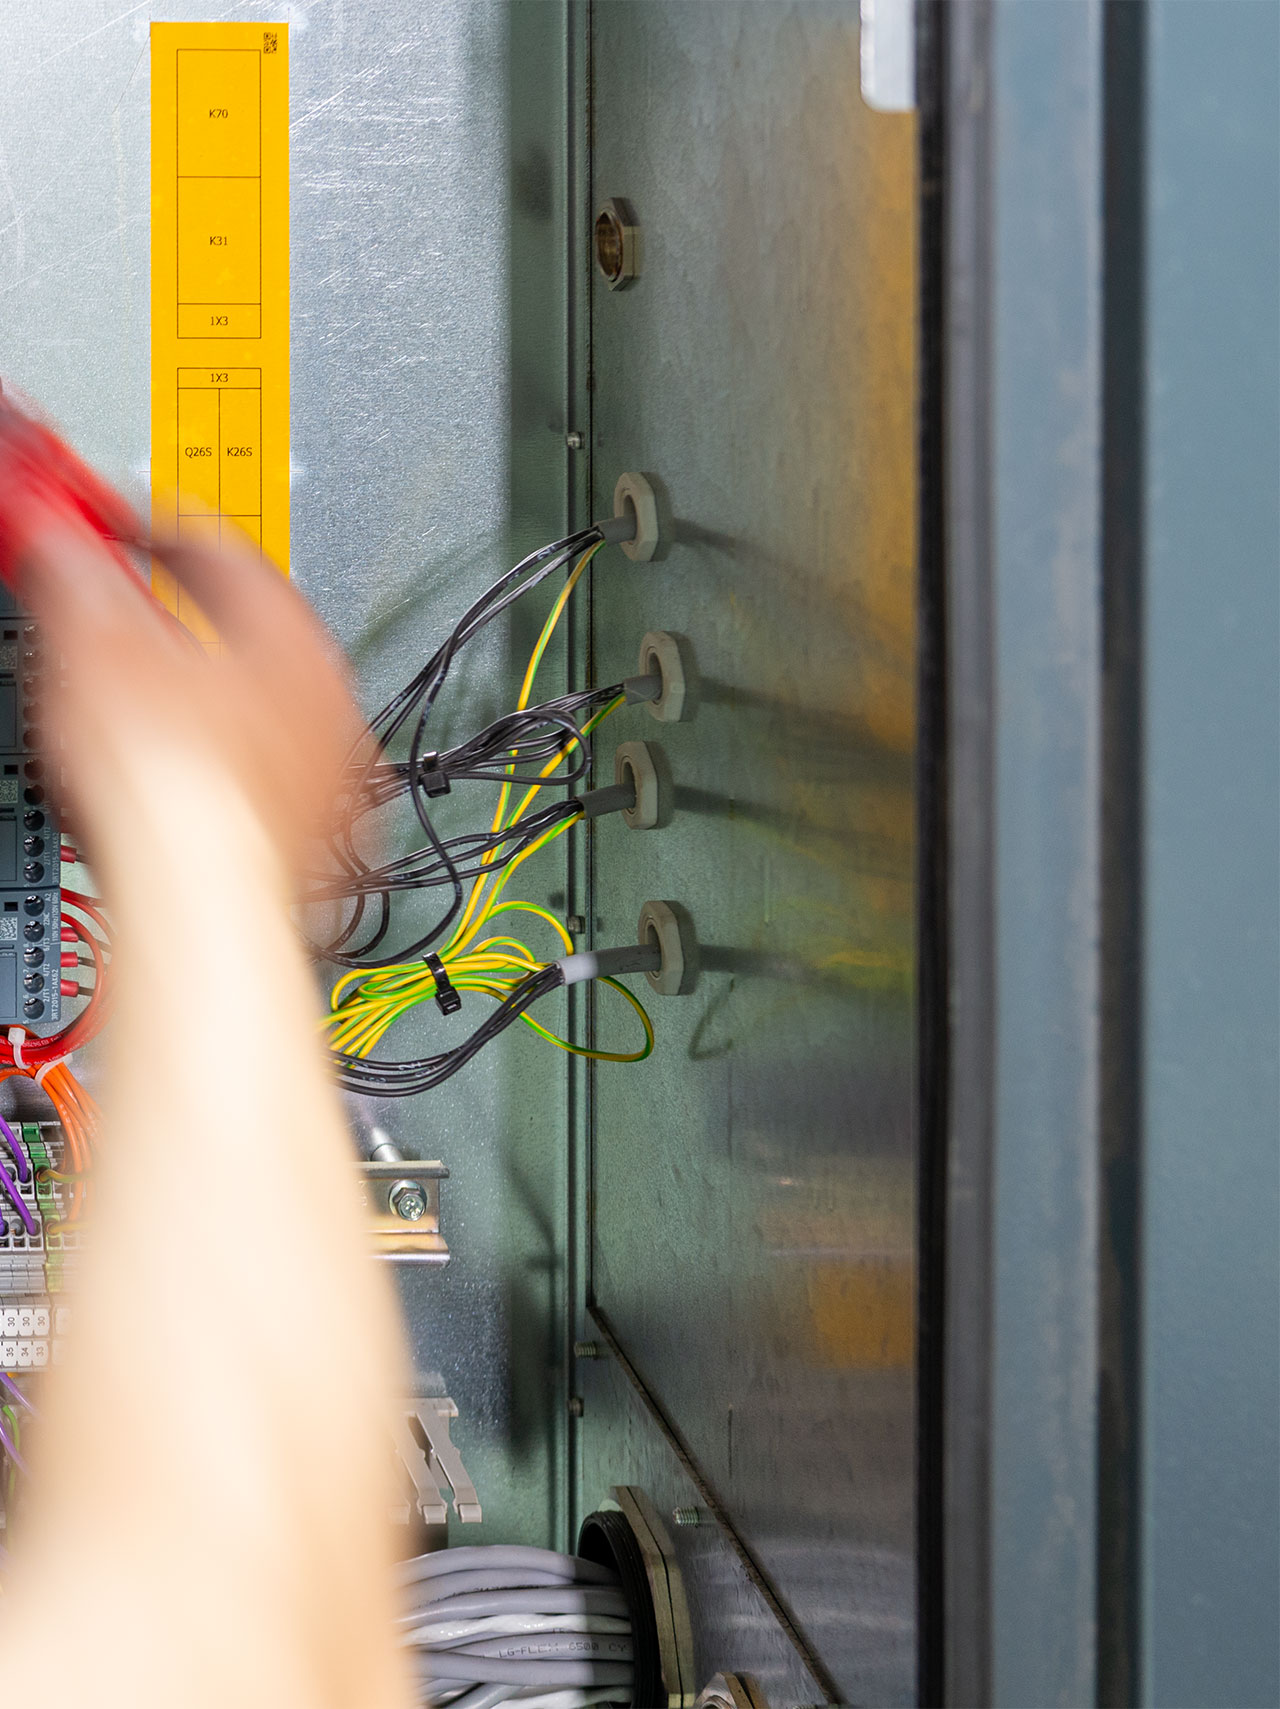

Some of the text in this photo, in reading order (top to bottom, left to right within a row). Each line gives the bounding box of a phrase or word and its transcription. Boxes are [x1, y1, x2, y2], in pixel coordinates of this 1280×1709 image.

[209, 109, 228, 118] K70
[210, 237, 227, 246] K31
[210, 317, 228, 325] 1X3
[210, 374, 228, 383] 1X3
[185, 448, 212, 458] Q26S
[227, 448, 252, 456] K26S
[8, 1317, 15, 1327] 30
[23, 1317, 30, 1326] 30
[38, 1316, 45, 1326] 30
[7, 1347, 14, 1357] 35
[22, 1347, 28, 1357] 34
[36, 1347, 44, 1357] 33
